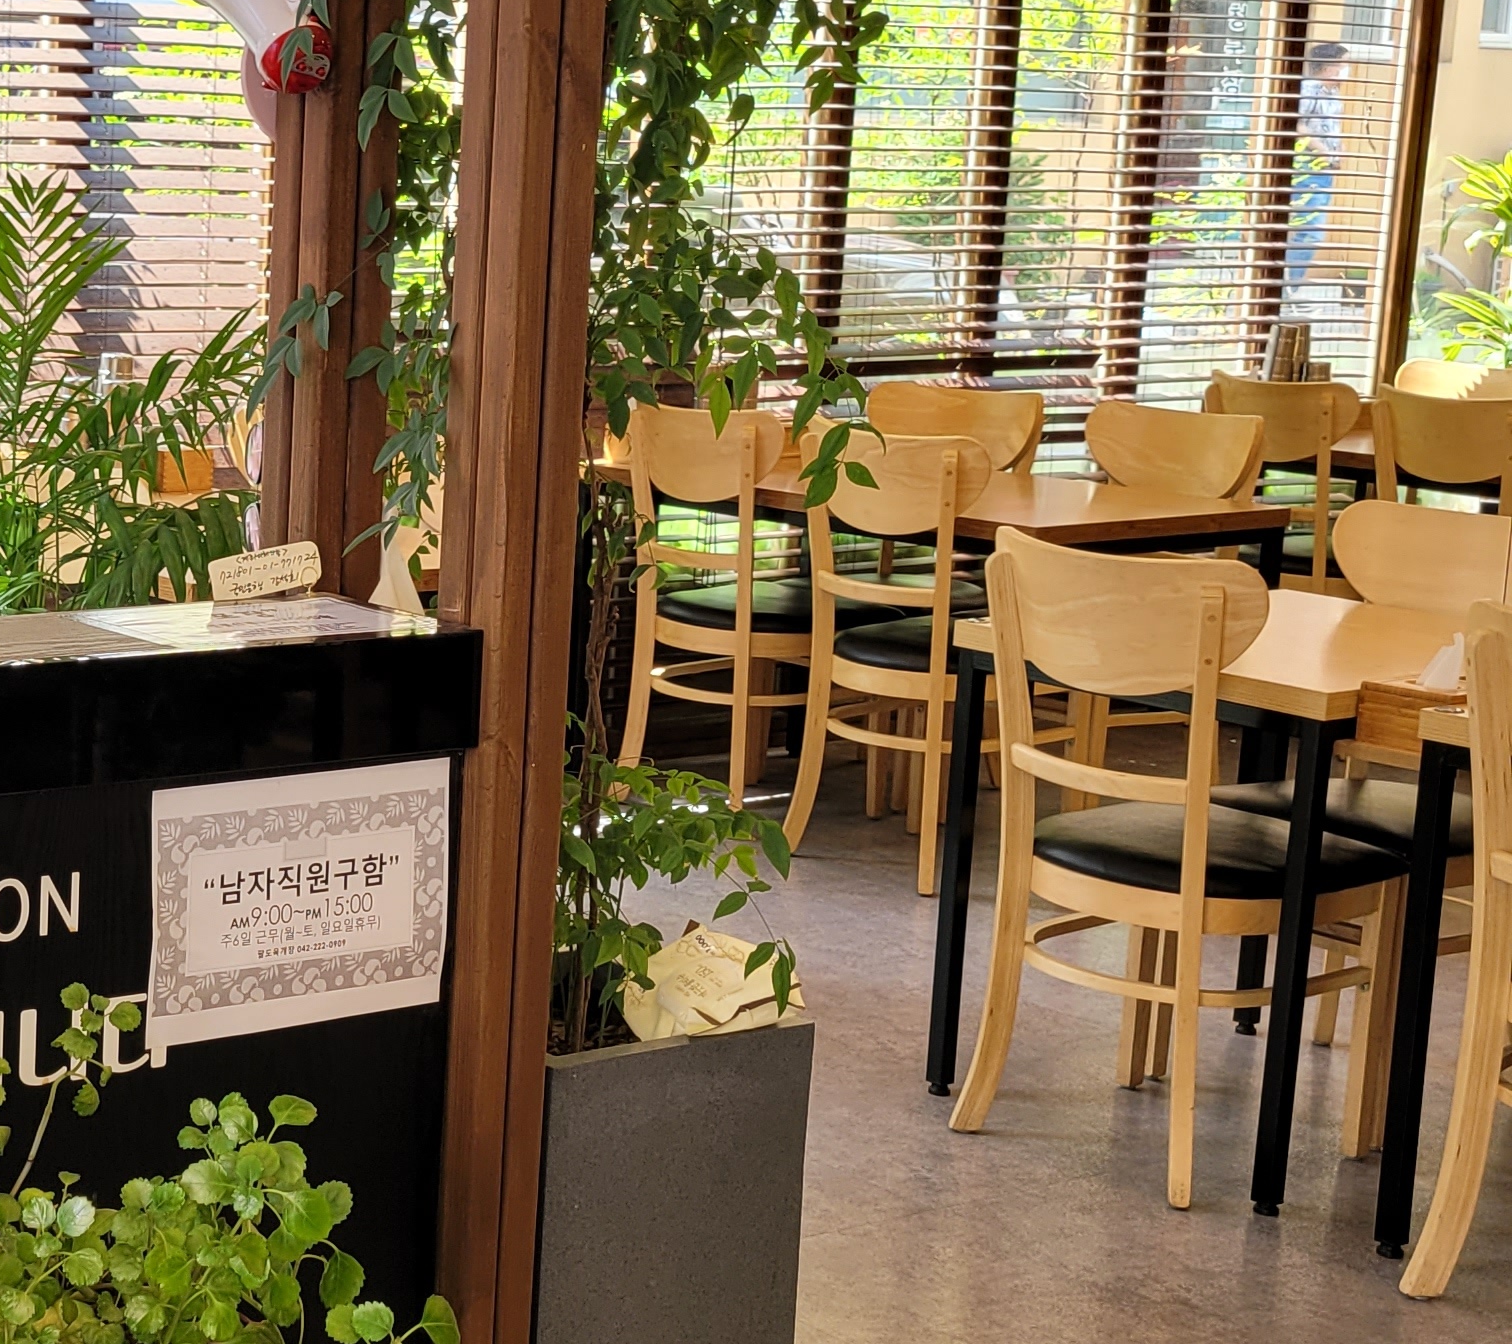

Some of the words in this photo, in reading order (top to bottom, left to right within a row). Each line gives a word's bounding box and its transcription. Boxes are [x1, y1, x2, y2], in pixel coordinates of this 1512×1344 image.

[220, 931, 251, 949] 주6일
[320, 914, 381, 935] 일요일휴무)
[257, 946, 295, 959] 팔도육개장
[297, 939, 346, 954] 042-222-0909
